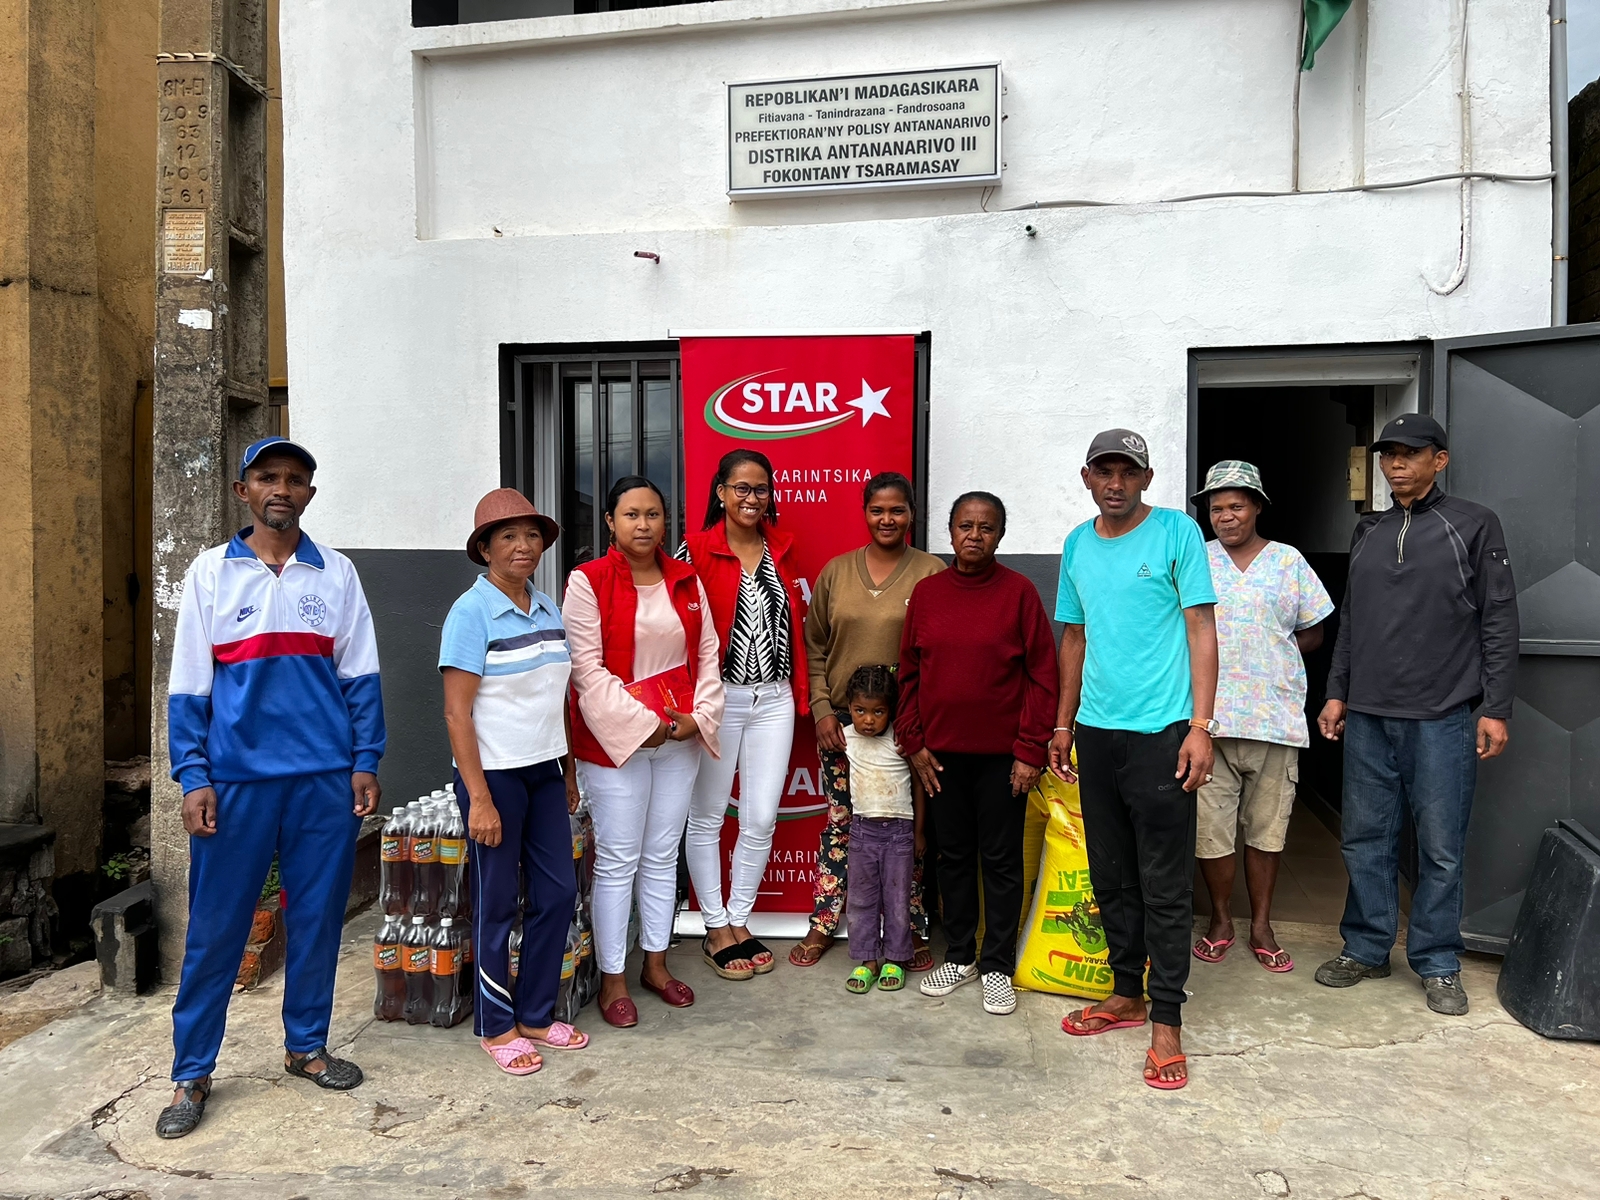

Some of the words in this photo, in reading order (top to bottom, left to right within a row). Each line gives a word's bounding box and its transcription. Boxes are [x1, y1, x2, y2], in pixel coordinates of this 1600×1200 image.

[745, 87, 849, 107] REPOBLIKAN'I
[854, 78, 979, 100] MADAGASIKARA
[758, 111, 805, 123] Fitiavana
[816, 105, 885, 119] Tanindrazana
[896, 101, 965, 114] Fandrosoana
[735, 124, 844, 143] PREFEKTIORAN'NY
[847, 122, 891, 137] POLISY
[894, 115, 991, 134] ANTANANARIVO
[748, 145, 822, 165] DISTRIKA
[827, 137, 955, 160] ANTANANARIVO
[961, 136, 977, 151] III
[763, 165, 851, 184] FOKONTANY
[855, 158, 960, 178] TSARAMASAY
[741, 382, 839, 414] STAR
[239, 605, 254, 616] NIKE
[1063, 960, 1113, 985] SIM
